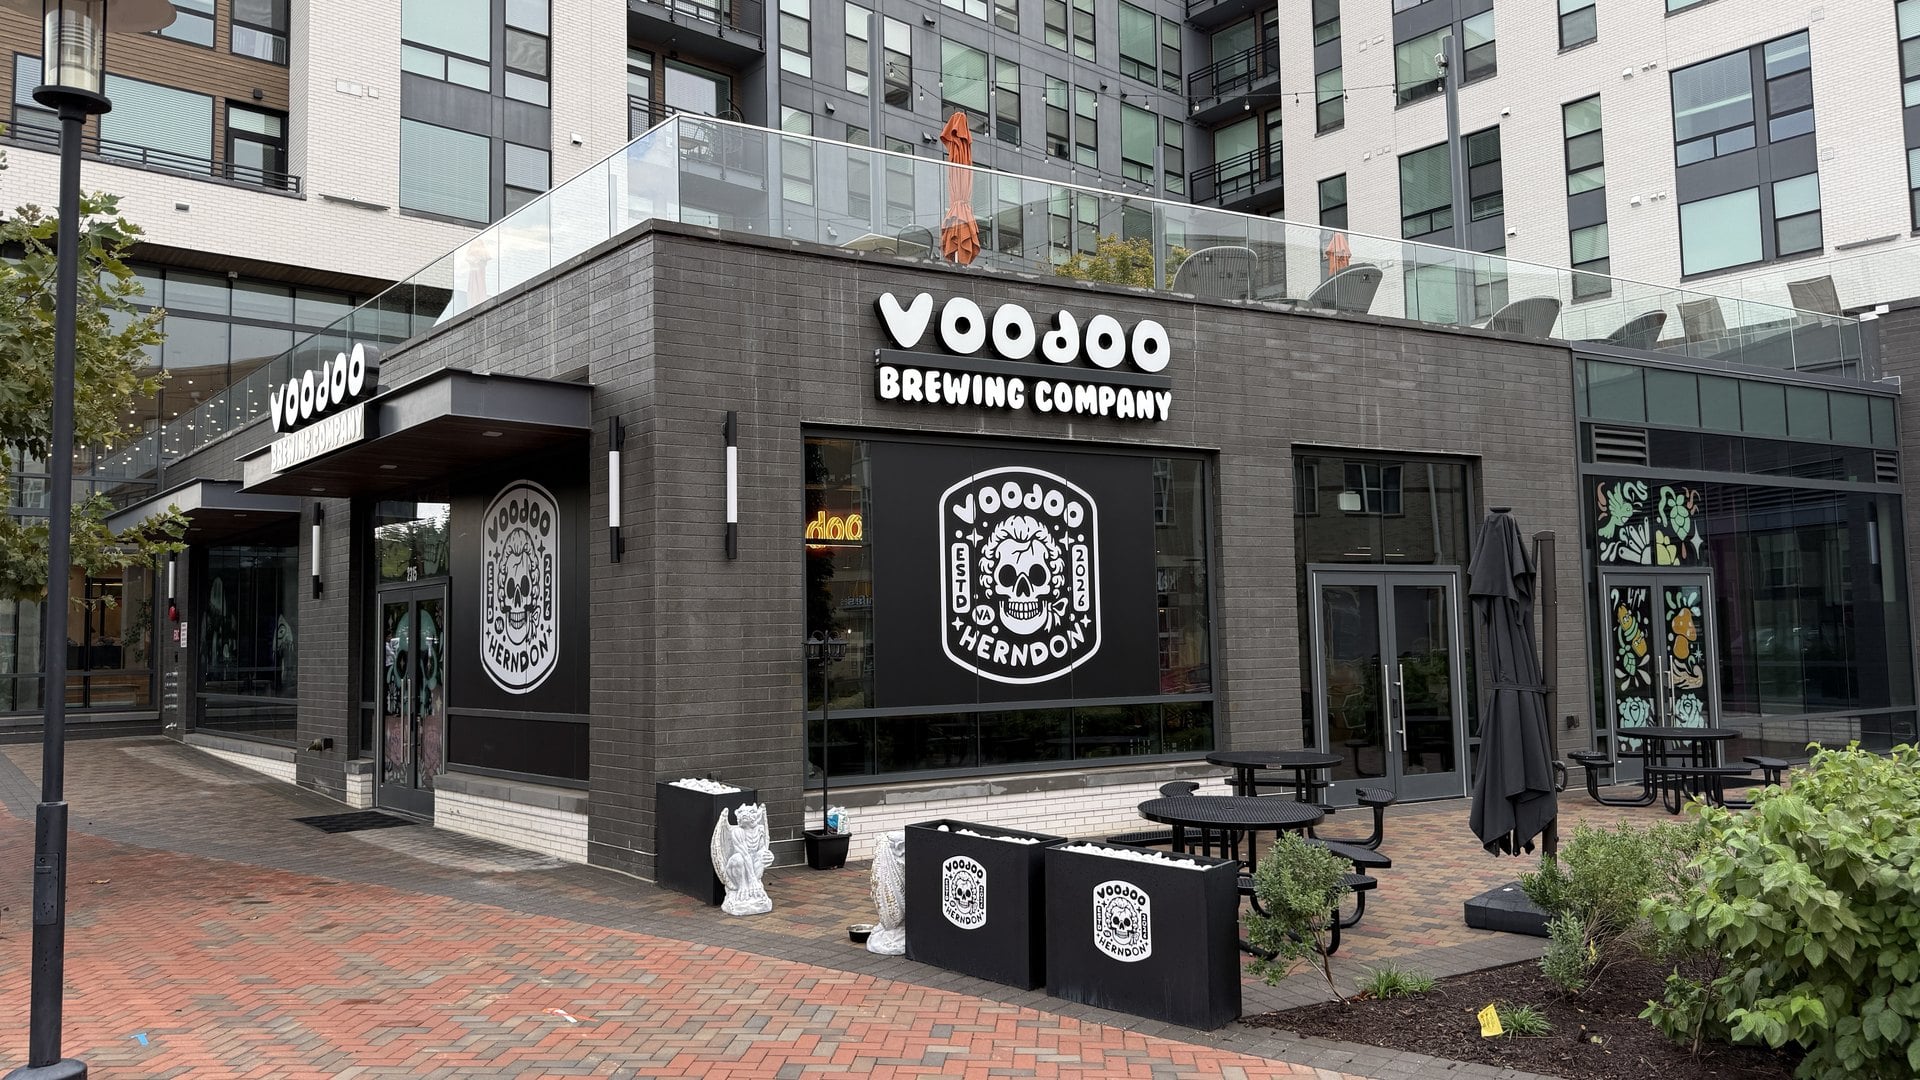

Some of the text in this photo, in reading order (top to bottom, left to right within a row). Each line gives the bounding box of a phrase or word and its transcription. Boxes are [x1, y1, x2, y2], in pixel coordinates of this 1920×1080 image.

[879, 366, 1172, 422] BREWING COMPANY
[271, 405, 364, 472] BREWING COMPANY
[487, 564, 495, 621] ESTD
[544, 557, 552, 618] 2026
[955, 547, 968, 609] ESTD
[1074, 548, 1087, 608] 2026
[974, 607, 992, 622] VA
[488, 632, 549, 674] HERNDON
[958, 621, 1085, 667] HERNDON
[945, 905, 983, 925] HERNDON
[1098, 936, 1146, 957] HERNDON
